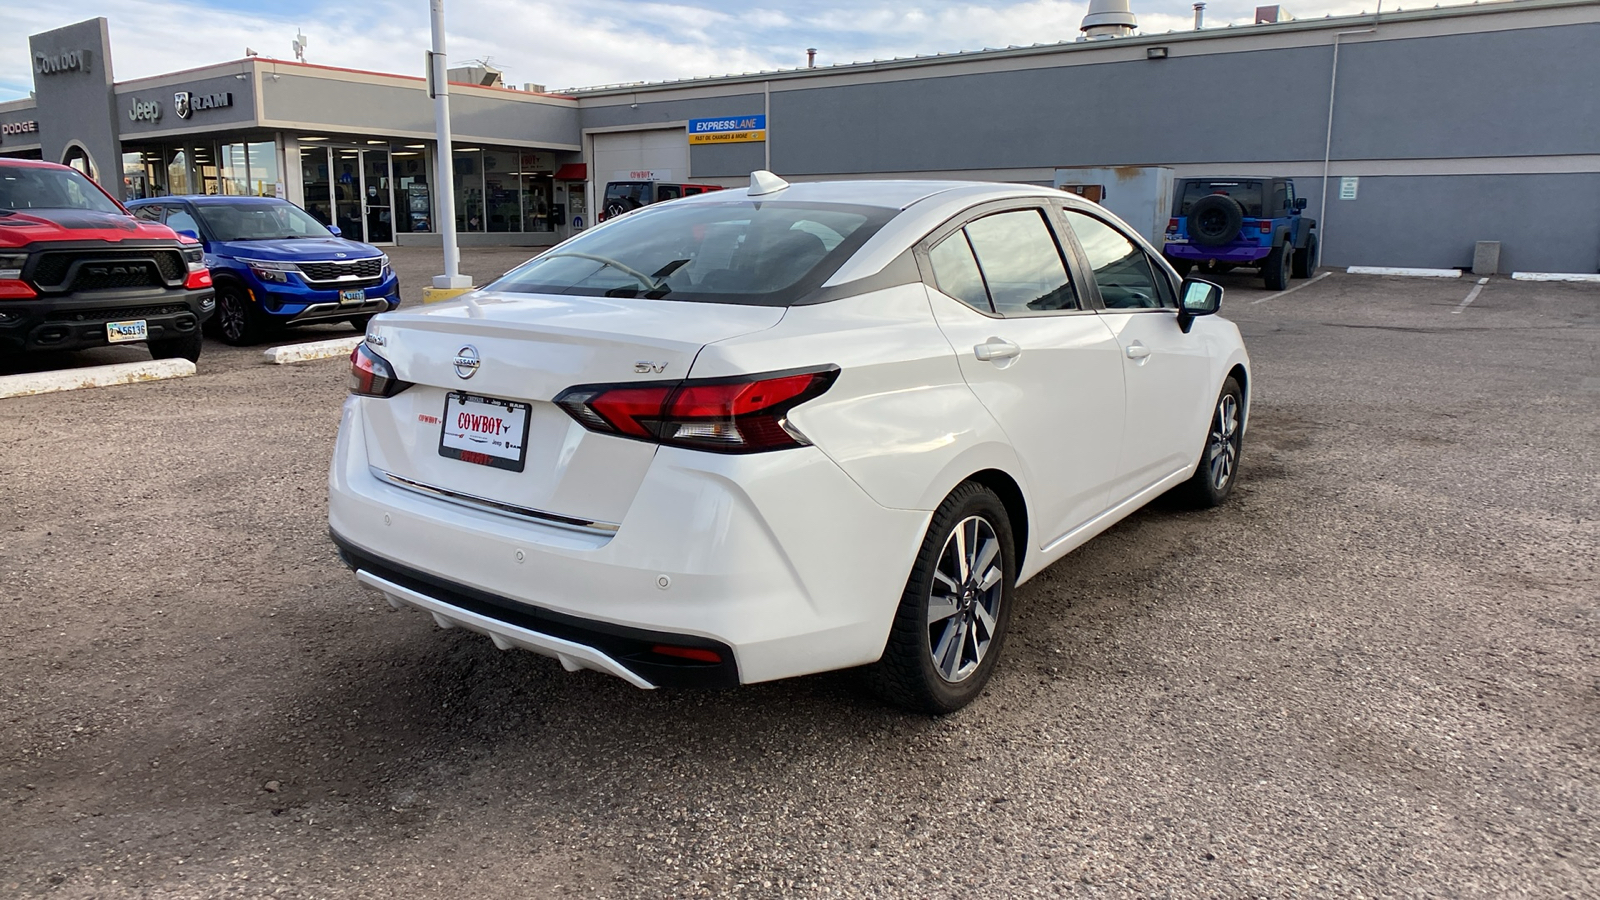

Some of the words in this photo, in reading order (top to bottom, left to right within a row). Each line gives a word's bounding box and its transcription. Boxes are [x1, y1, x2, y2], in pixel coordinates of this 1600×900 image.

[191, 92, 228, 110] RAM
[128, 97, 159, 123] Jeep
[2, 120, 35, 134] DODGE
[88, 266, 147, 275] RAM
[634, 360, 669, 373] SV
[418, 414, 438, 424] COWBOY
[458, 412, 503, 435] COWBOY
